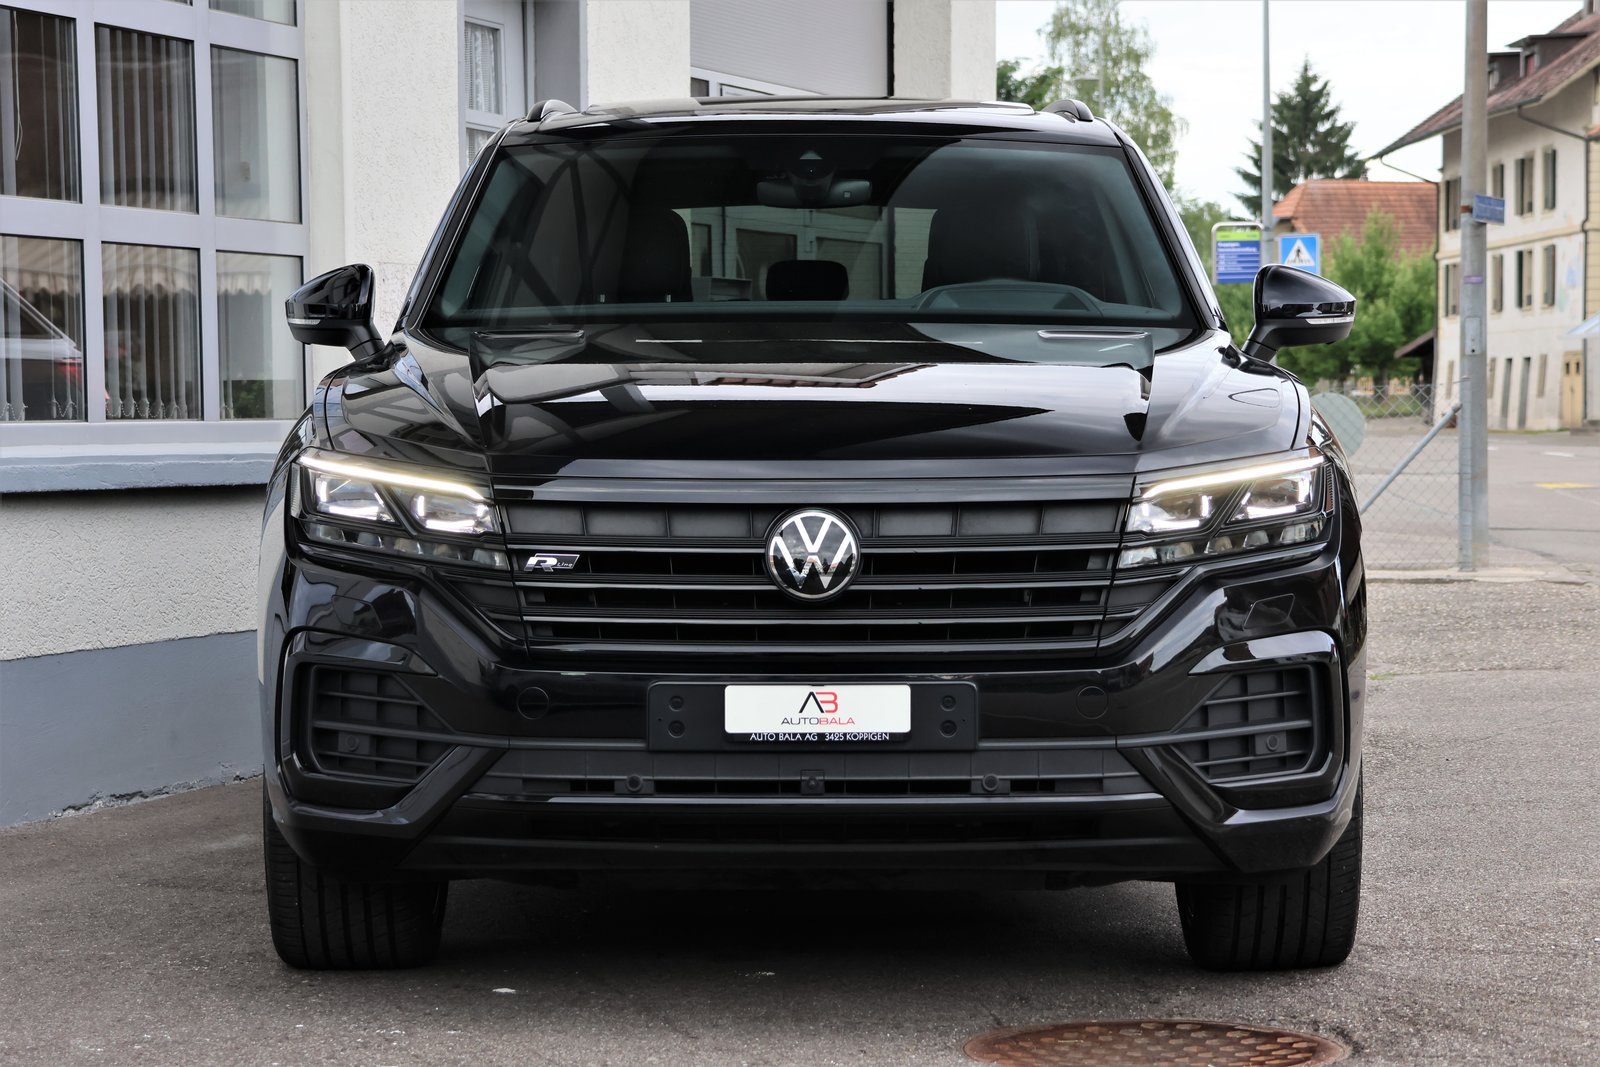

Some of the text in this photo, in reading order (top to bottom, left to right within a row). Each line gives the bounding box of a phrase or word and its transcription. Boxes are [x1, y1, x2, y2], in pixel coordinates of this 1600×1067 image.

[768, 509, 858, 599] VW
[524, 556, 558, 572] R
[799, 691, 839, 713] AB
[781, 717, 855, 725] AUTOBALA
[750, 733, 890, 741] AUTO BALA AG 3425 KOPPIGEN
